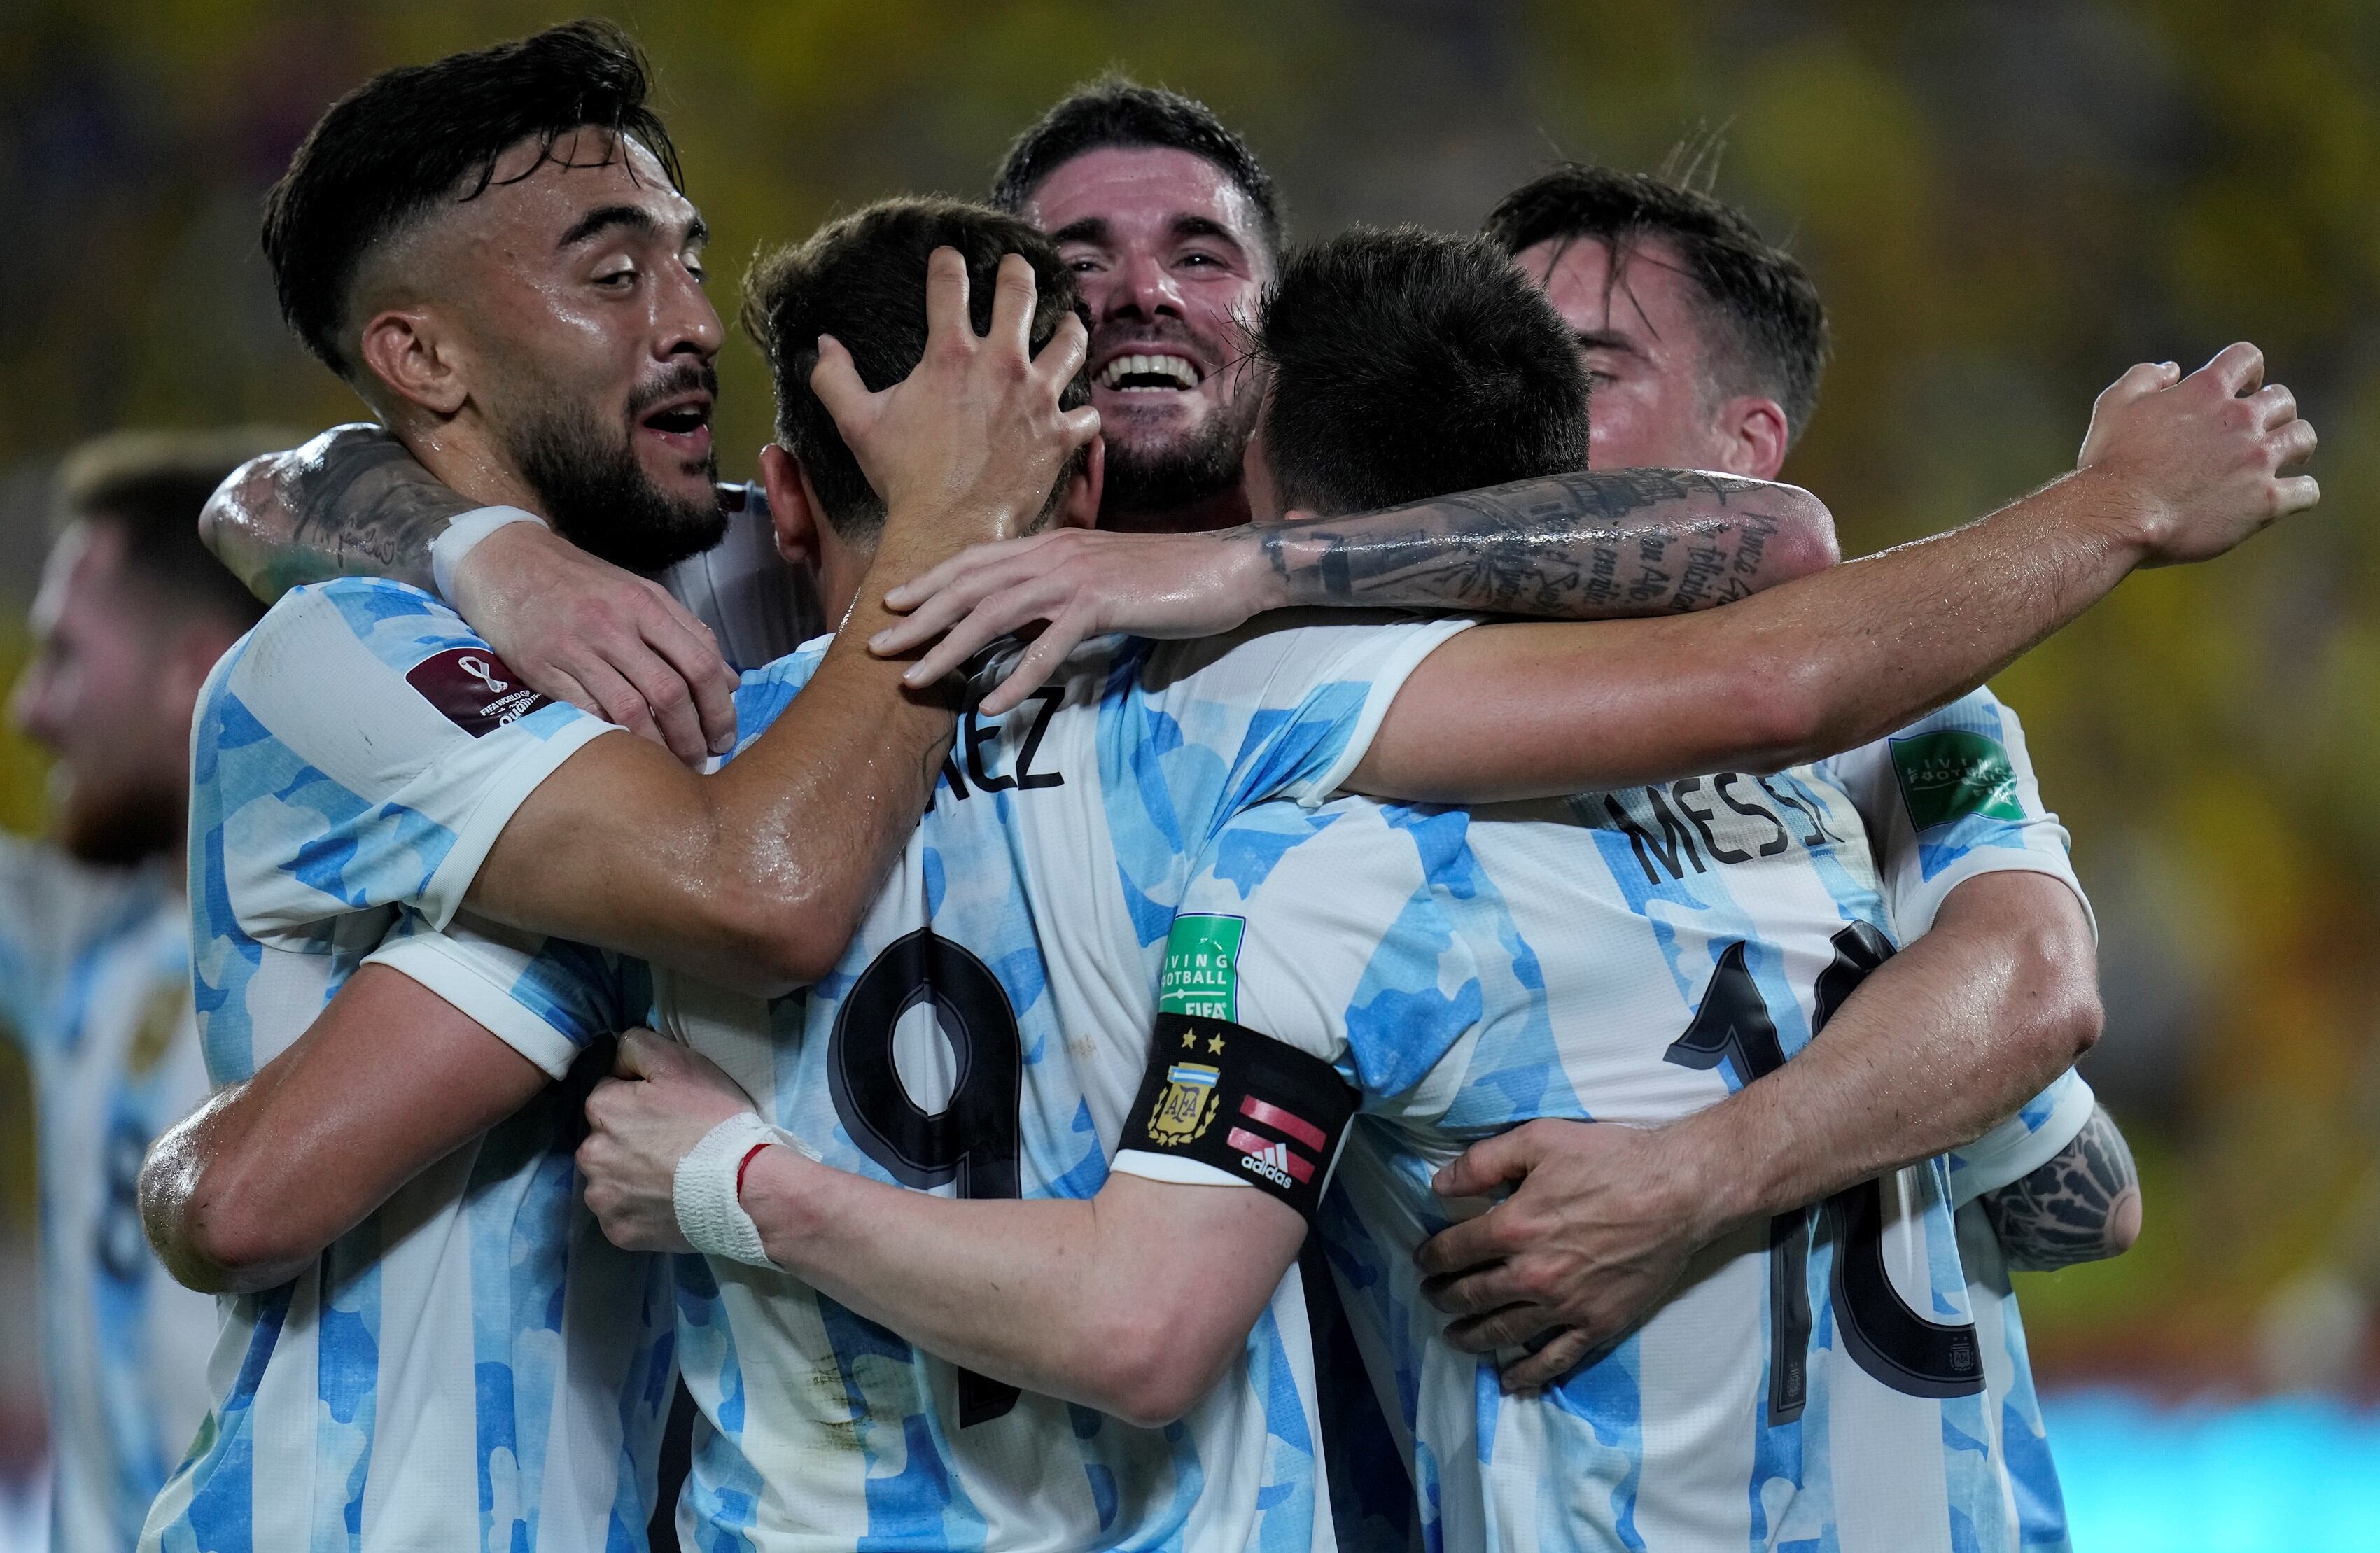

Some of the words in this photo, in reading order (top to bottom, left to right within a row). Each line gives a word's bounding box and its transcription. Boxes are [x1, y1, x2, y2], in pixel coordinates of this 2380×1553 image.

[479, 702, 500, 717] FIFA
[496, 692, 522, 707] WORLD
[1164, 953, 1228, 971] IVING
[1161, 970, 1227, 988] OOTBALL
[1185, 1002, 1227, 1020] FIFA
[1163, 1083, 1200, 1123] AFA
[827, 925, 1023, 1431] 9
[1241, 1155, 1293, 1189] adidas
